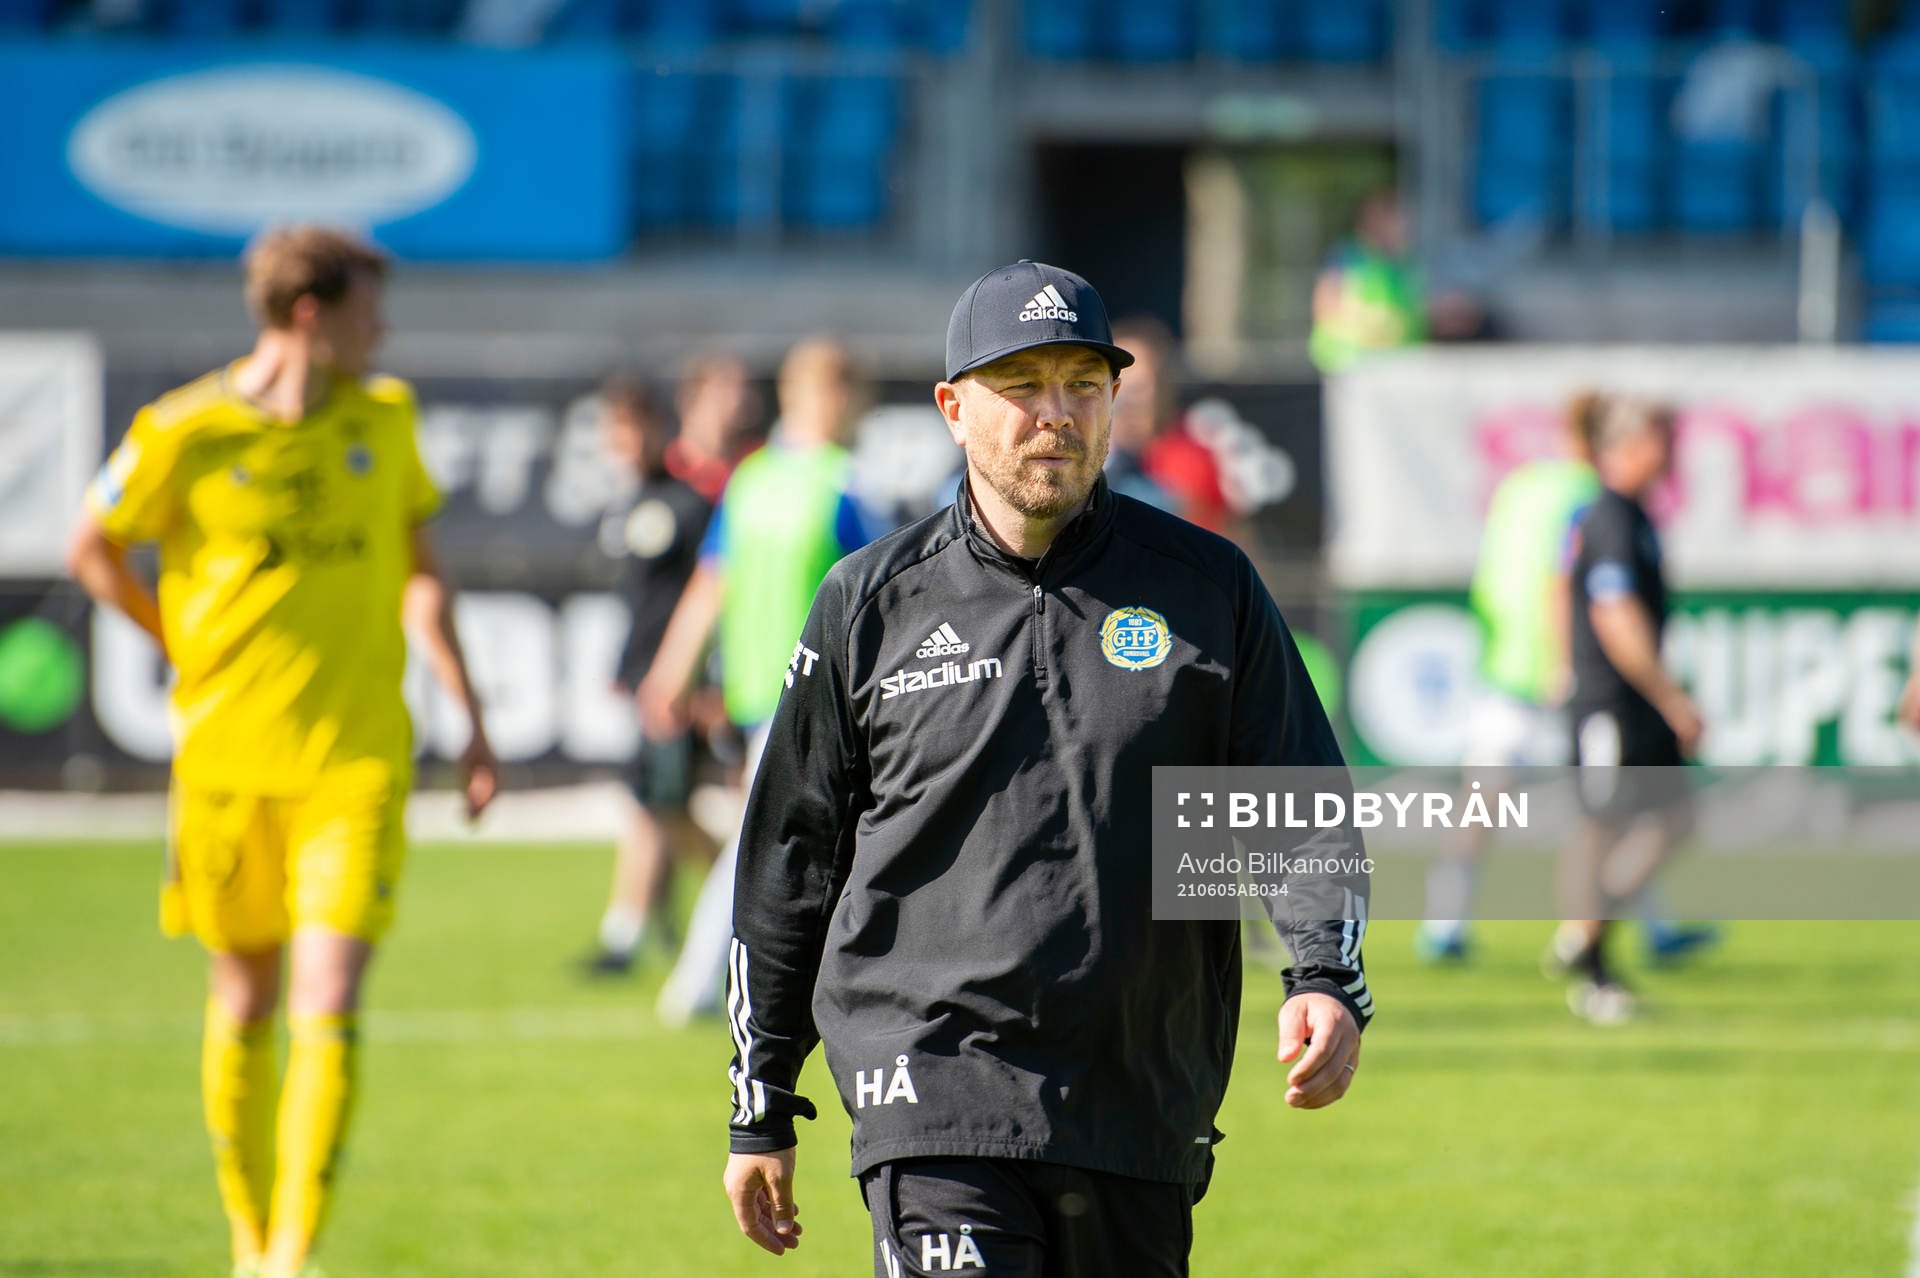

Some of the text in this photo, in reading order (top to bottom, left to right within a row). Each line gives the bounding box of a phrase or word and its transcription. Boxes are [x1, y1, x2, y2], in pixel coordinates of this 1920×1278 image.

[1019, 306, 1078, 322] adidas
[916, 643, 970, 658] adidas
[880, 658, 1003, 700] stadium
[856, 1054, 919, 1109] HÅ
[921, 1223, 986, 1271] HÅ
